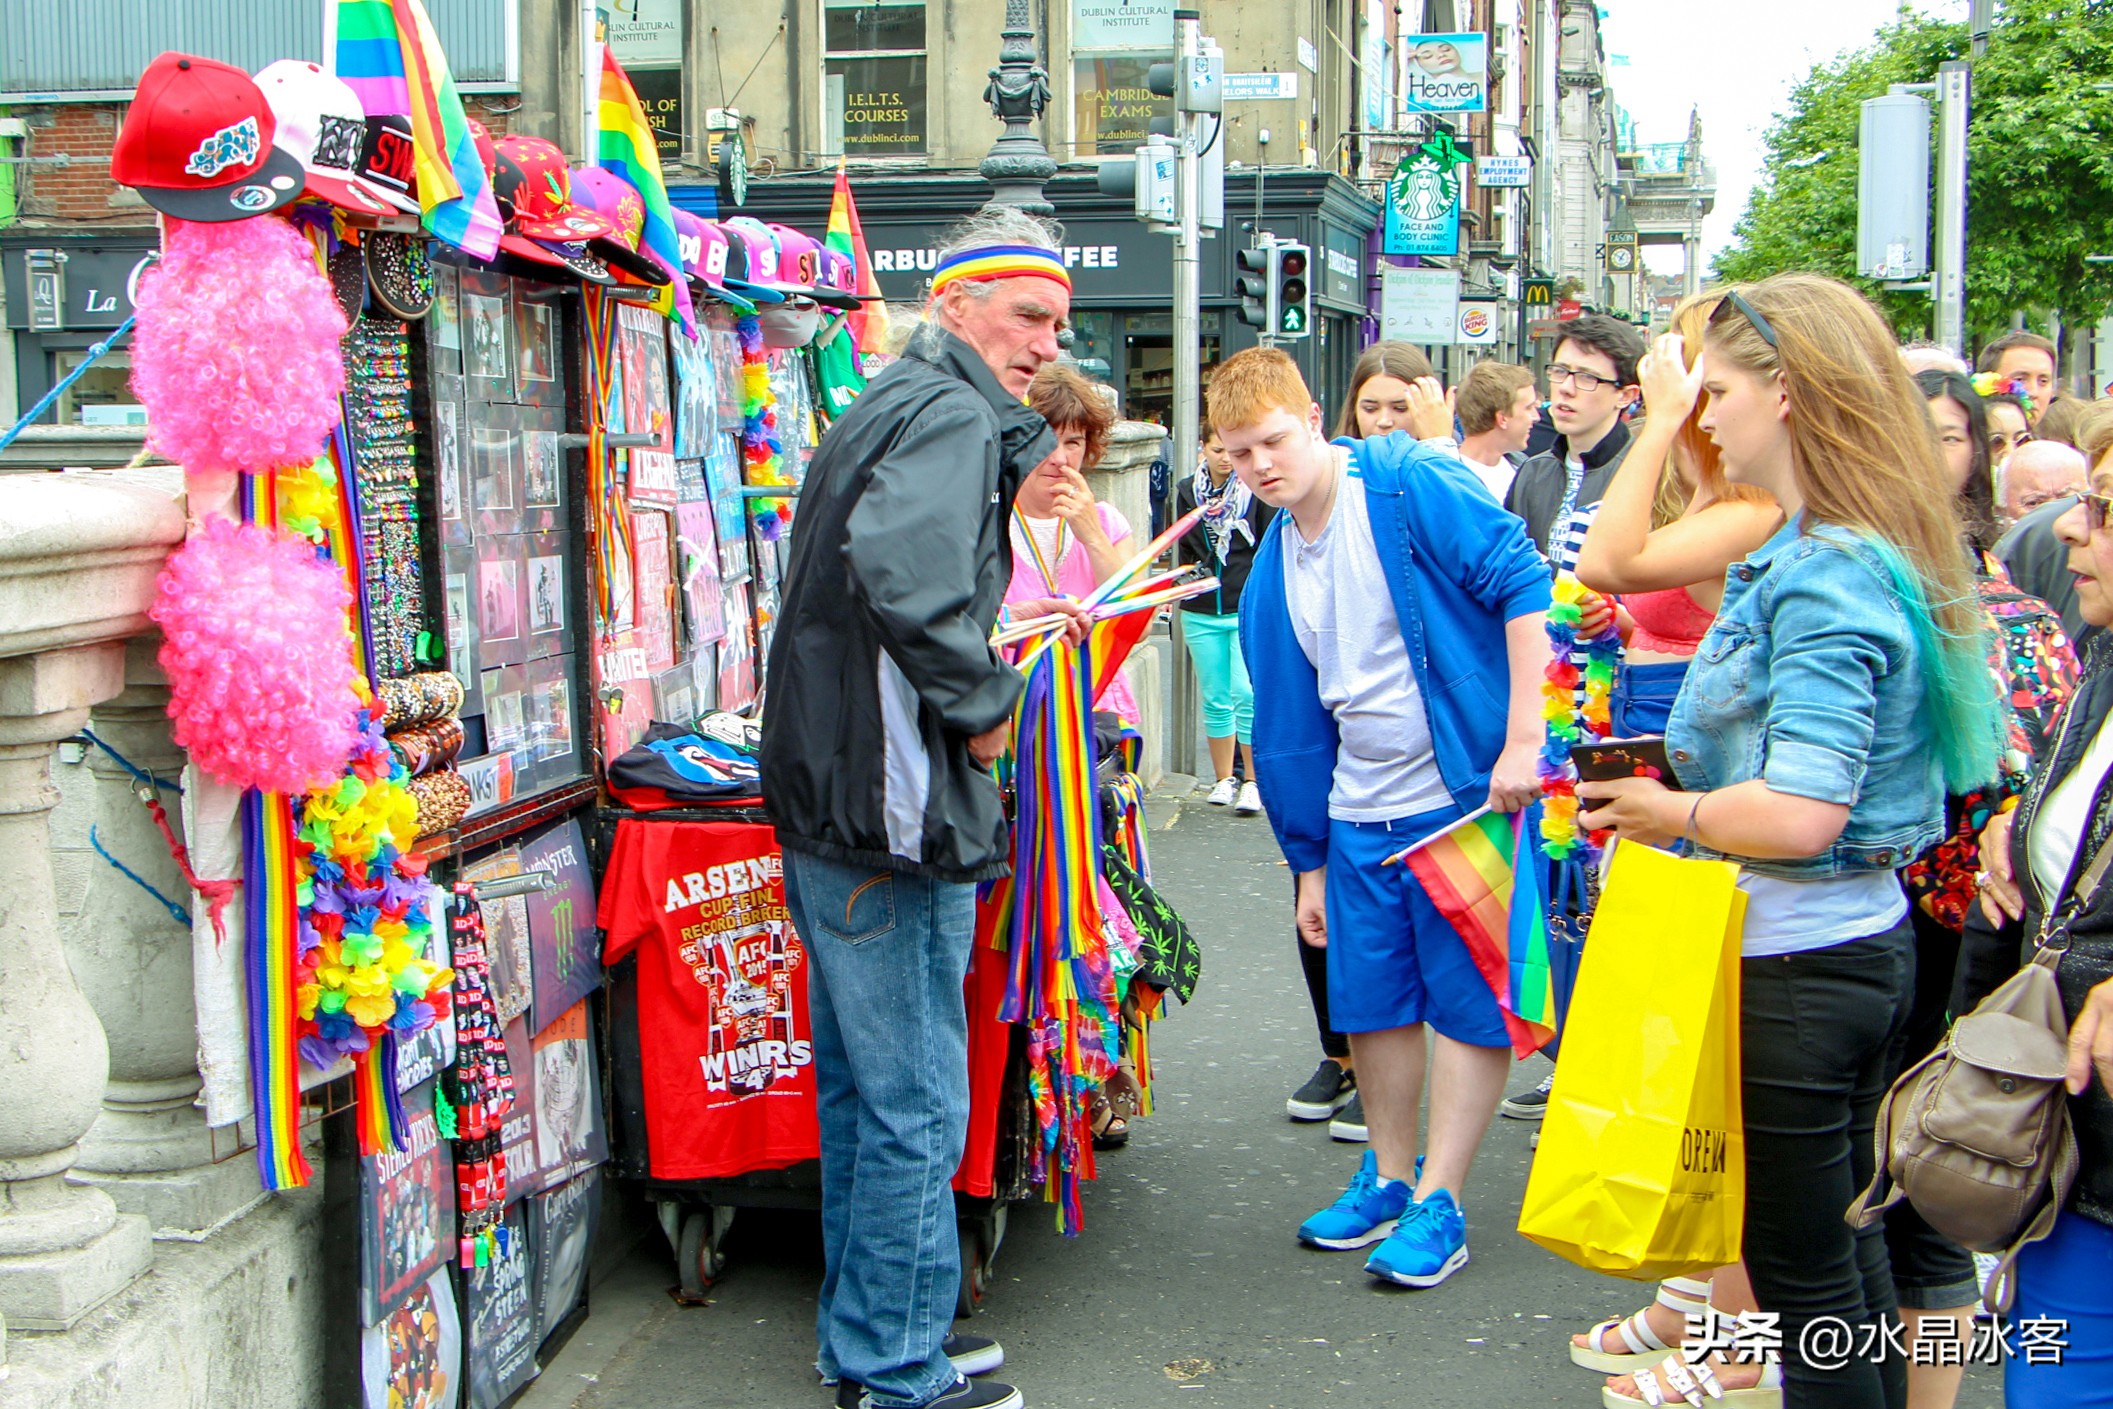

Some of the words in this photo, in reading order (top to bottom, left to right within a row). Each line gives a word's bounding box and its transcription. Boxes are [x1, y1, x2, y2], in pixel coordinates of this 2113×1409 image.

[1081, 8, 1116, 17] DUBLIN
[1118, 7, 1169, 16] CULTURAL
[628, 21, 675, 31] CULTURAL
[1102, 18, 1150, 27] INSTITUTE
[613, 33, 658, 42] INSTITUTE
[1409, 72, 1481, 104] Heaven
[657, 99, 677, 111] OF
[848, 93, 904, 106] I.E.L.T.S.
[844, 109, 909, 122] COURSES
[1100, 105, 1153, 118] EXAMS
[1479, 167, 1528, 175] EMPLOYMENT
[1488, 176, 1519, 184] AGENCY
[1400, 223, 1422, 231] FACE
[1393, 233, 1418, 241] BODY
[1419, 233, 1449, 241] CLINIC
[1609, 233, 1634, 242] EASON
[1056, 246, 1118, 268] FEE
[85, 289, 117, 312] La
[1464, 314, 1487, 323] BURGER
[1464, 320, 1488, 330] KING
[700, 896, 733, 918] CUP
[681, 915, 736, 941] RECORD
[681, 944, 699, 957] AFC
[784, 950, 801, 959] AFC
[773, 973, 791, 984] AFC
[719, 1007, 734, 1018] AFC
[746, 1068, 764, 1090] 4
[501, 1113, 532, 1145] 2013
